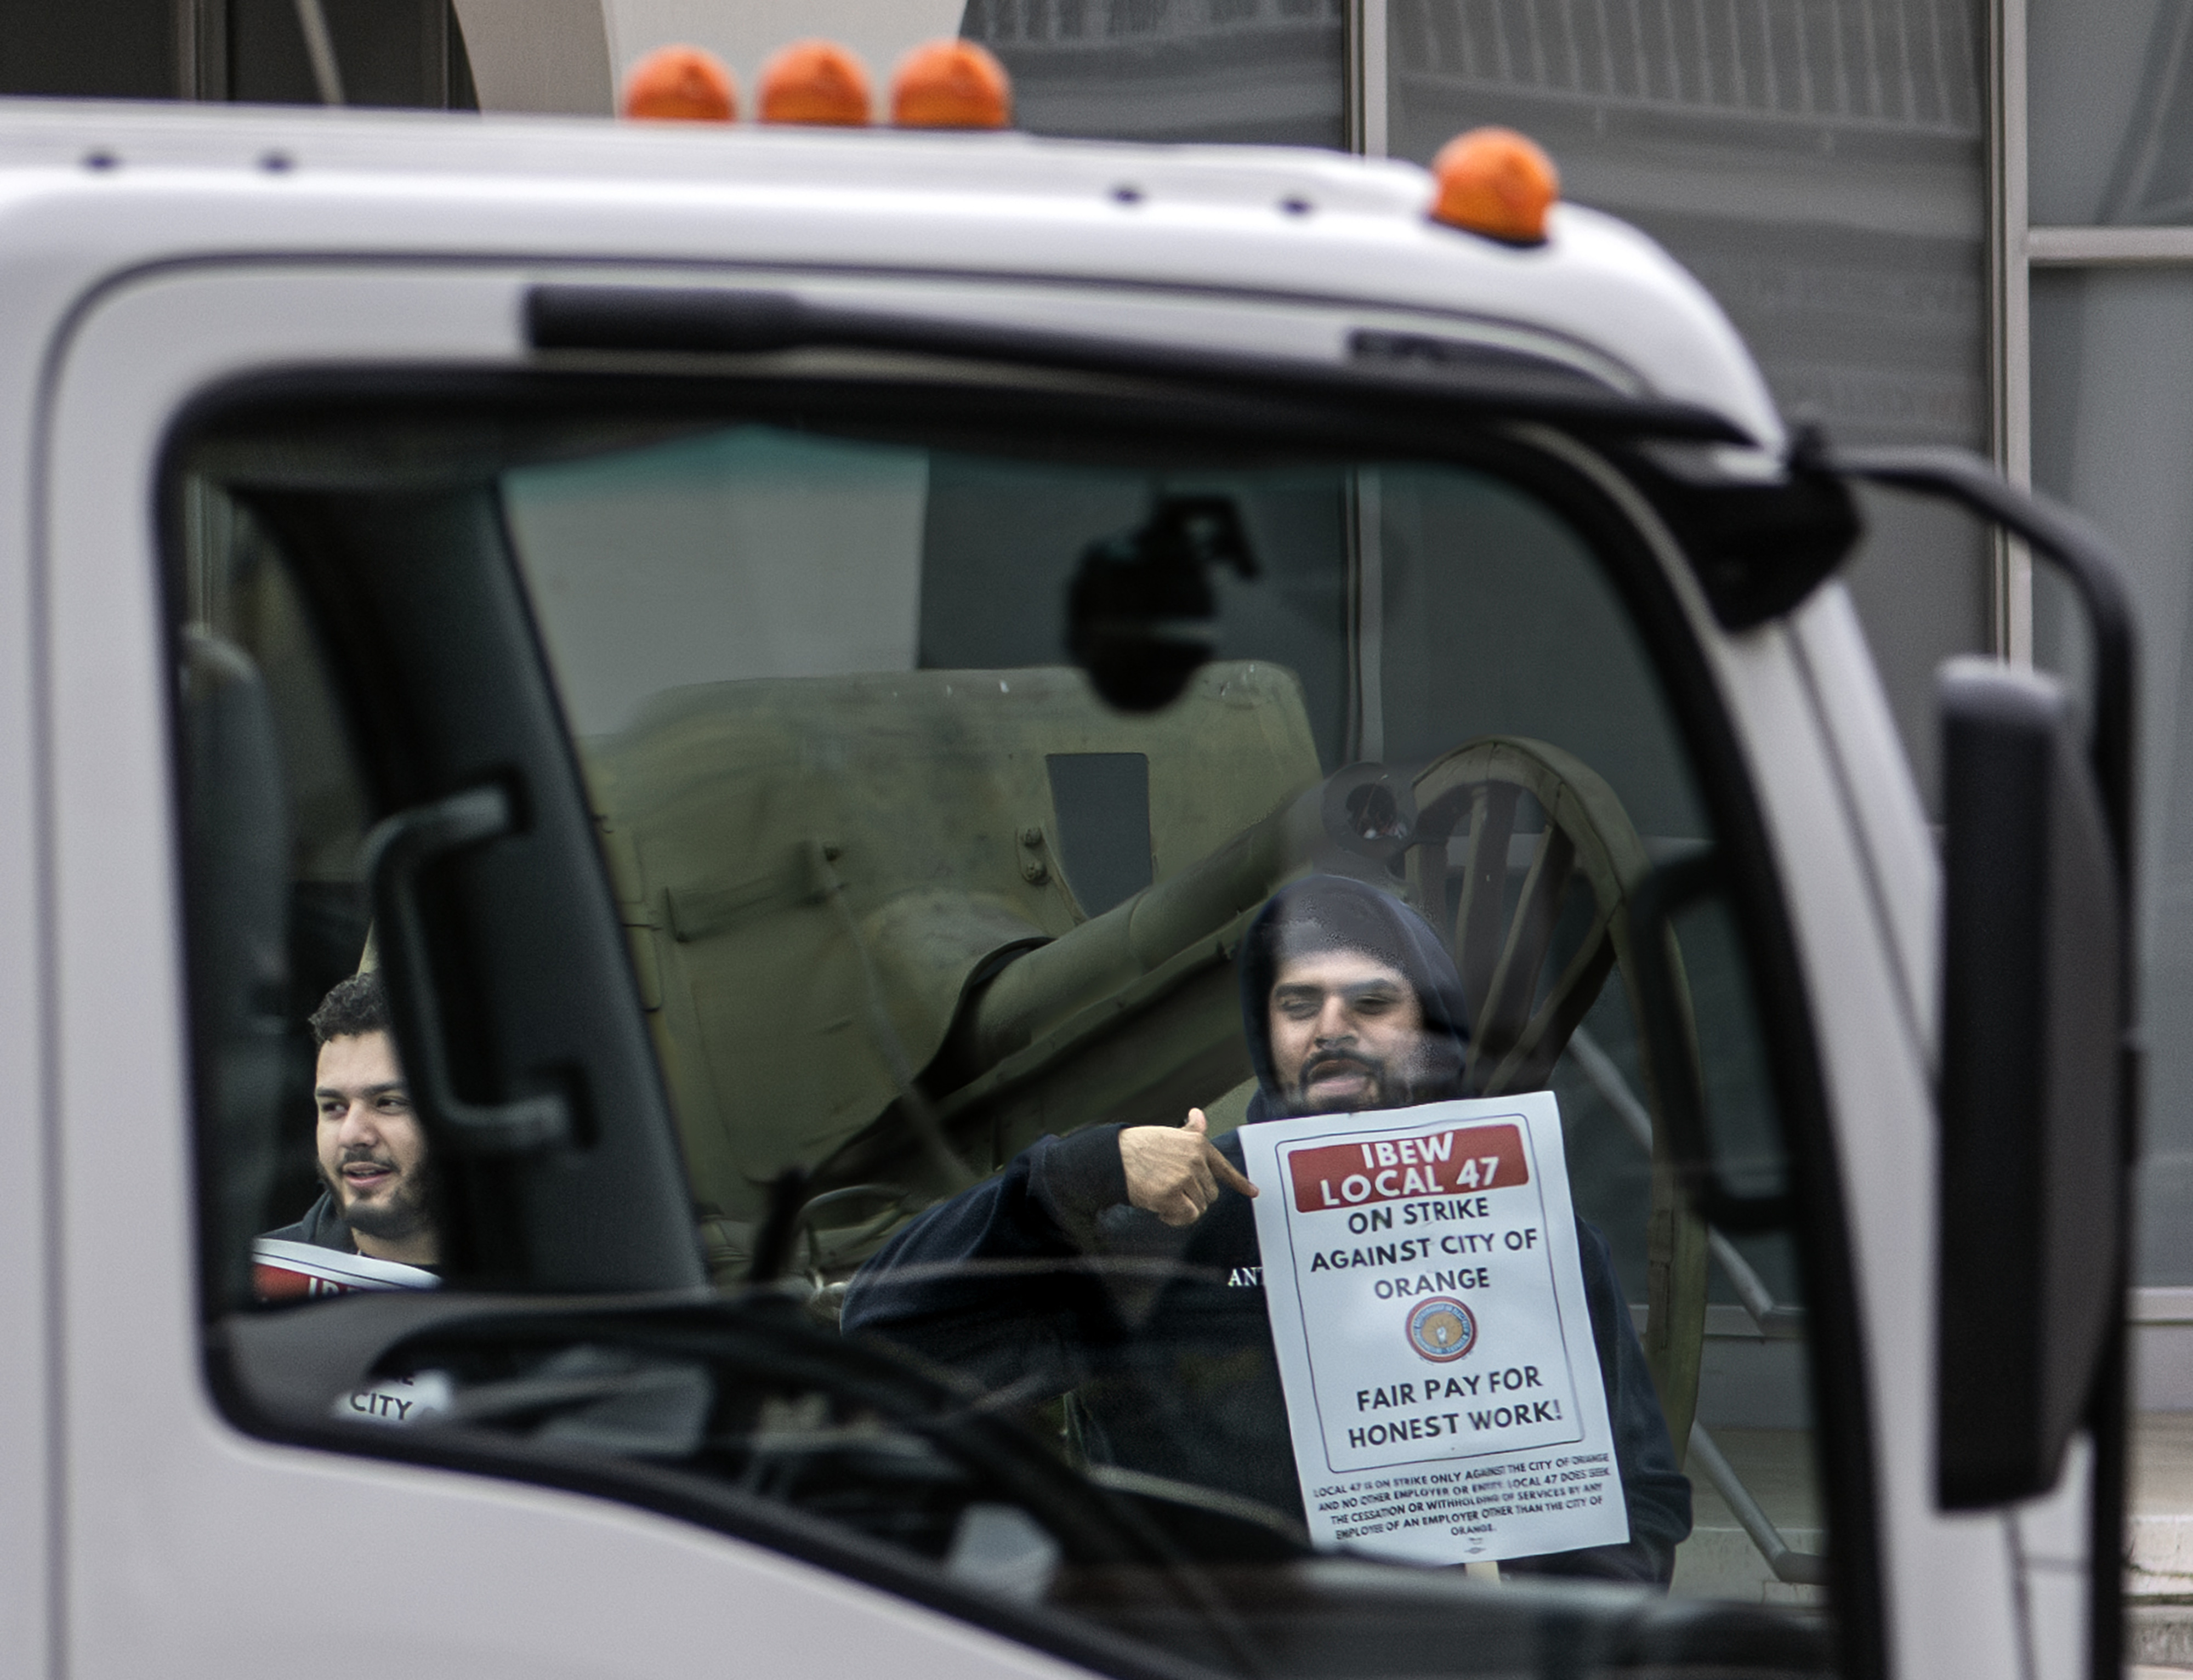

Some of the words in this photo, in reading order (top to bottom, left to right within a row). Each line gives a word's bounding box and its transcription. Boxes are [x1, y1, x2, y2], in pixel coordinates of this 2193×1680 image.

[1362, 1132, 1454, 1169] IBEW
[1321, 1165, 1444, 1206] LOCAL
[1456, 1157, 1499, 1188] 47
[1348, 1207, 1393, 1234] ON
[1404, 1197, 1489, 1225] STRIKE
[1311, 1239, 1430, 1272] AGAINST
[1441, 1233, 1496, 1255] CITY
[1504, 1228, 1538, 1251] OF
[1374, 1267, 1490, 1299] ORANGE
[350, 1393, 413, 1420] CITY
[1356, 1383, 1417, 1412] FAIR
[1424, 1375, 1480, 1400] PAY
[1489, 1365, 1543, 1394] FOR
[1348, 1413, 1459, 1449] HONEST
[1468, 1399, 1563, 1431] WORK!
[1313, 1485, 1347, 1497] LOCAL
[1350, 1483, 1361, 1491] 47
[1365, 1481, 1373, 1490] IS
[1375, 1479, 1390, 1488] ON
[1393, 1475, 1426, 1486] STRIKE
[1430, 1472, 1461, 1484] ONLY
[1465, 1465, 1505, 1480] AGAINST
[1508, 1463, 1526, 1473] THE
[1529, 1460, 1552, 1471] CITY
[1556, 1457, 1569, 1467] OF
[1572, 1453, 1609, 1465] ORANGE
[1318, 1501, 1339, 1511] AND
[1342, 1497, 1357, 1507] NO
[1360, 1492, 1391, 1505] OTHER
[1393, 1487, 1448, 1500] EMPLOYER
[1452, 1485, 1469, 1494] OR
[1507, 1477, 1541, 1489] LOCAL
[1544, 1474, 1558, 1484] 47
[1560, 1469, 1587, 1482] DOES
[1589, 1467, 1611, 1478] SEEK
[1331, 1513, 1348, 1524] THE
[1351, 1505, 1405, 1522] CESSATION
[1408, 1502, 1424, 1513] OR
[1426, 1494, 1499, 1510] WITHHOLDING
[1502, 1492, 1514, 1501] OF
[1518, 1486, 1566, 1501] SERVICES
[1568, 1485, 1580, 1495] BY
[1583, 1483, 1603, 1492] ANY
[1336, 1524, 1383, 1540] EMPLOYEE
[1386, 1520, 1400, 1531] OF
[1404, 1518, 1419, 1528] AN
[1422, 1510, 1479, 1525] EMPLOYER
[1481, 1505, 1514, 1518] OTHER
[1515, 1503, 1543, 1514] THAN
[1546, 1502, 1563, 1511] THE
[1566, 1498, 1587, 1508] CITY
[1589, 1495, 1603, 1505] OF
